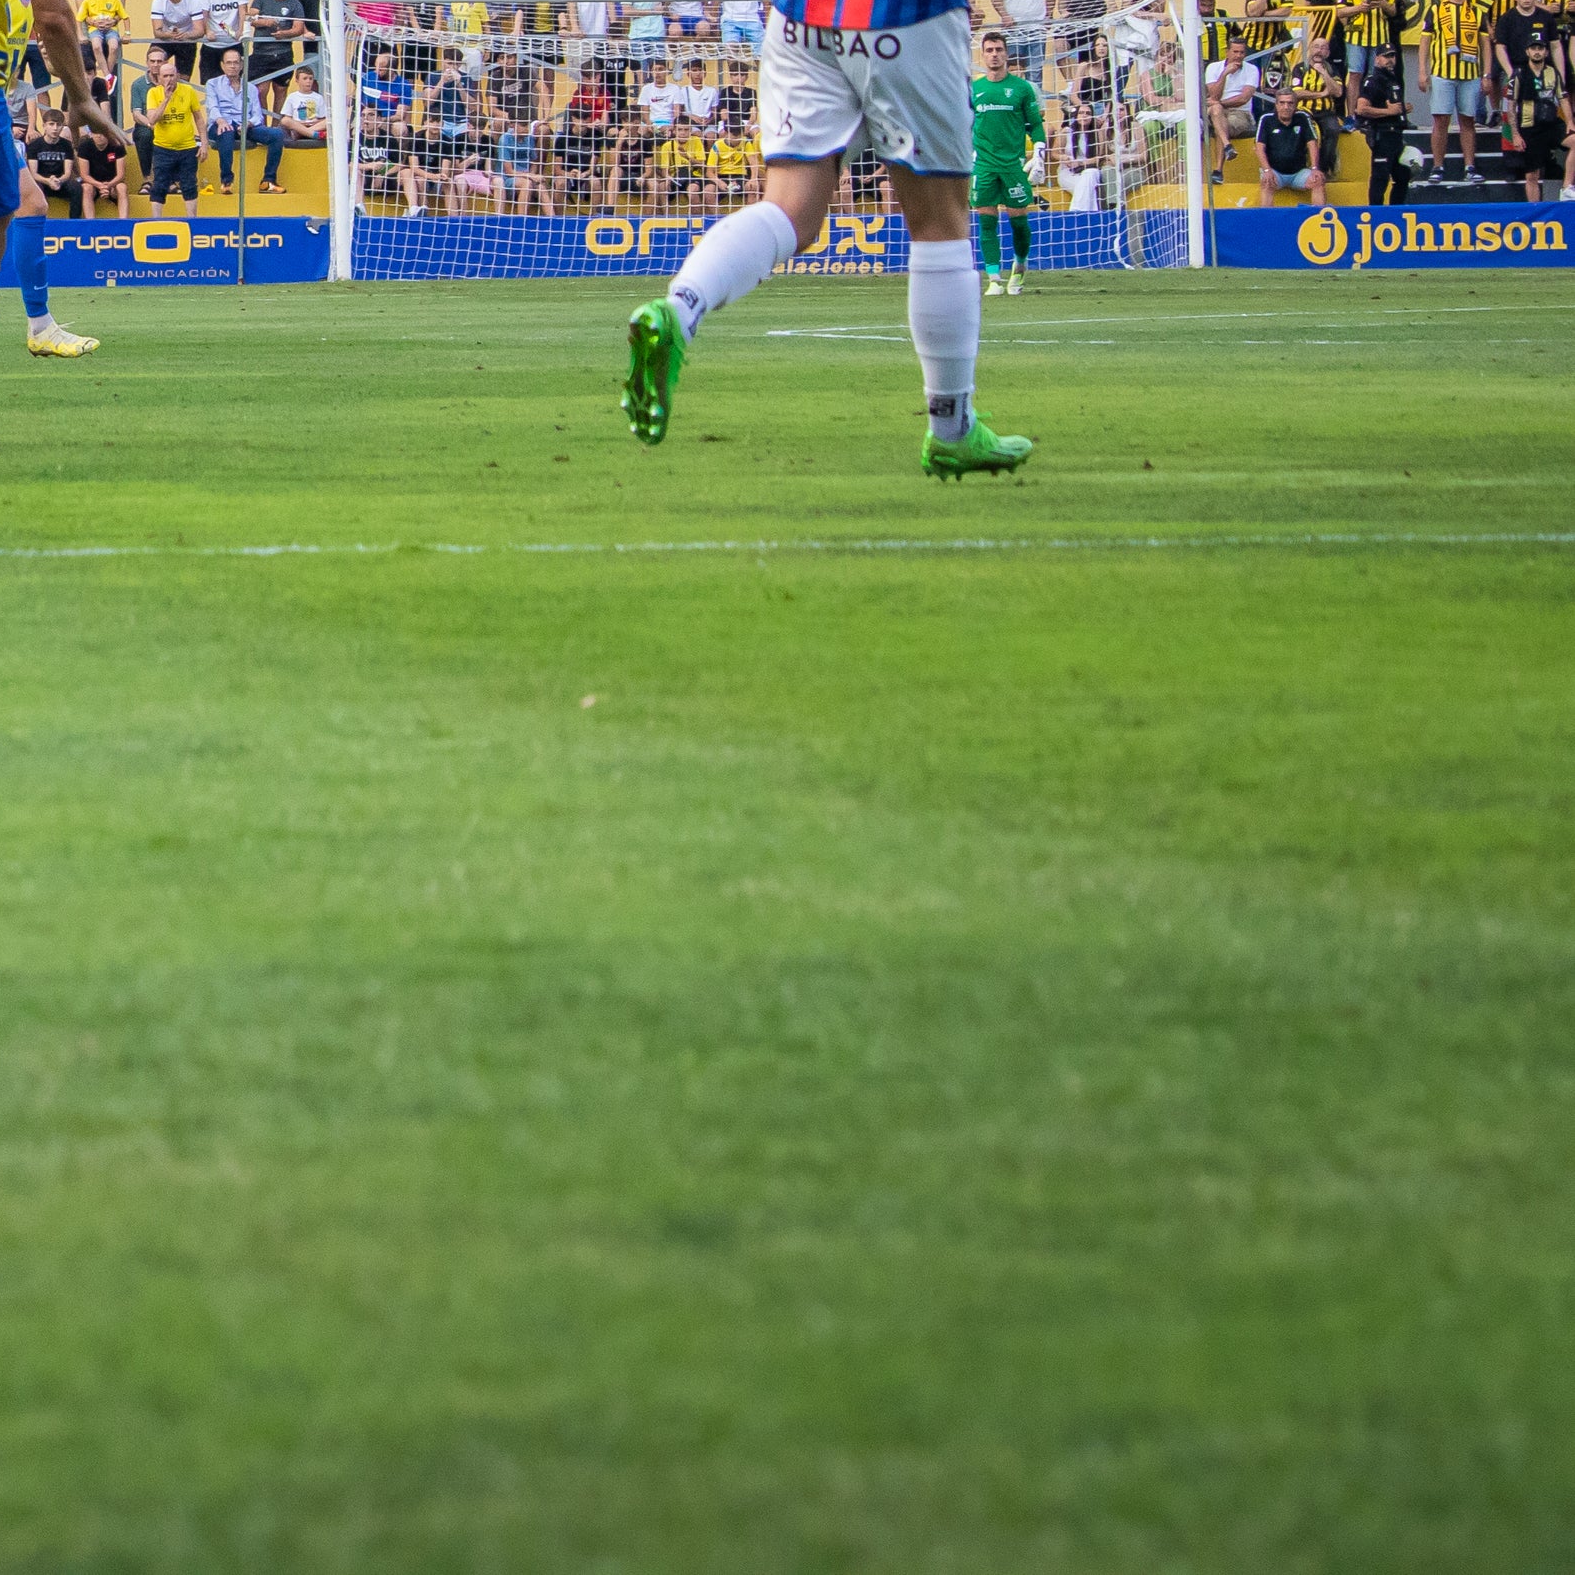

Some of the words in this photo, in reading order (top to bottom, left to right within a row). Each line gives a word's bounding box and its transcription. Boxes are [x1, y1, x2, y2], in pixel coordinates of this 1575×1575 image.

[211, 2, 239, 12] ICONO
[783, 18, 902, 60] BILBAO
[43, 236, 132, 255] grupo
[1352, 213, 1567, 264] johnson
[94, 266, 231, 279] COMUNICACIÓN
